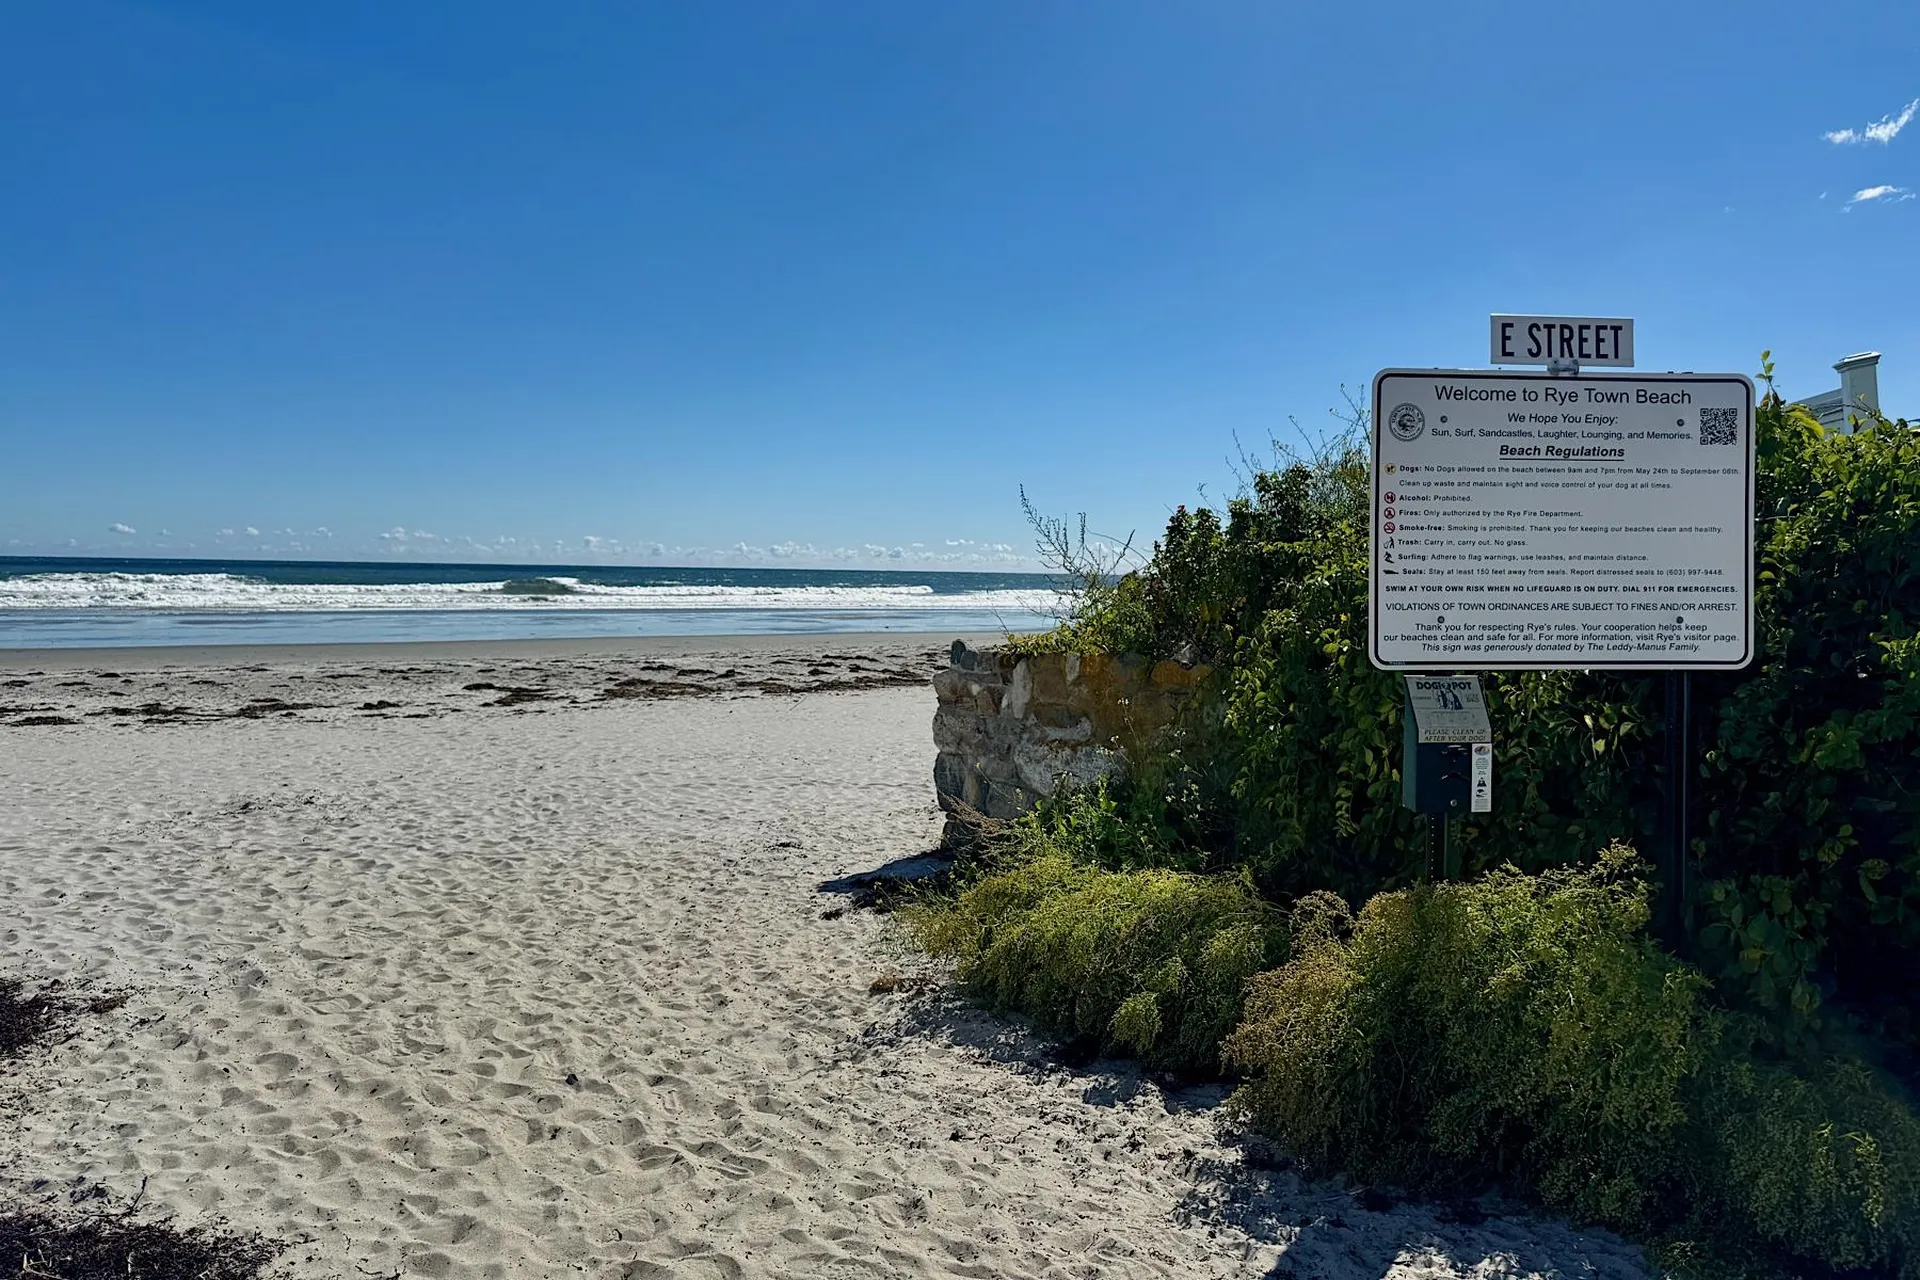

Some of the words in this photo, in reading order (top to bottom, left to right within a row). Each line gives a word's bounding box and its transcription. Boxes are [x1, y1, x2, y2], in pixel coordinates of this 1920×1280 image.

[1501, 322, 1514, 356] E
[1527, 324, 1623, 359] STREET
[1435, 386, 1516, 401] Welcome
[1522, 388, 1538, 401] to
[1545, 387, 1578, 406] Rye
[1584, 388, 1629, 403] Town
[1636, 389, 1691, 404] Beach
[1508, 412, 1526, 422] We
[1529, 413, 1558, 425] Hope
[1561, 413, 1581, 423] You
[1585, 414, 1618, 426] Enjoy:
[1431, 428, 1452, 437] Sun,
[1455, 428, 1476, 437] Surf,
[1478, 429, 1535, 438] Sandcastles,
[1538, 430, 1579, 440] Laughter,
[1581, 430, 1625, 440] Lounging,
[1499, 445, 1541, 455] Beach
[1545, 446, 1625, 459] Regulations
[1399, 465, 1422, 473] Dogs:
[1423, 509, 1440, 517] Only
[1398, 553, 1428, 561] Surfing:
[1386, 602, 1440, 610] VIOLATIONS
[1488, 602, 1549, 610] ORDINANCES
[1550, 602, 1570, 610] ARE
[1415, 623, 1442, 631] Thank
[1464, 623, 1476, 631] for
[1478, 623, 1524, 632] respecting
[1527, 623, 1551, 632] Rye's
[1604, 623, 1656, 632] cooperation
[1658, 623, 1683, 632] helps
[1685, 624, 1707, 632] keep
[1581, 633, 1633, 641] information,
[1656, 632, 1681, 642] Rye's
[1422, 643, 1440, 651] This
[1443, 644, 1461, 653] sign
[1484, 643, 1533, 652] generously
[1574, 643, 1585, 652] by
[1607, 643, 1666, 652] Leddy-Manus
[1669, 642, 1700, 652] Family.
